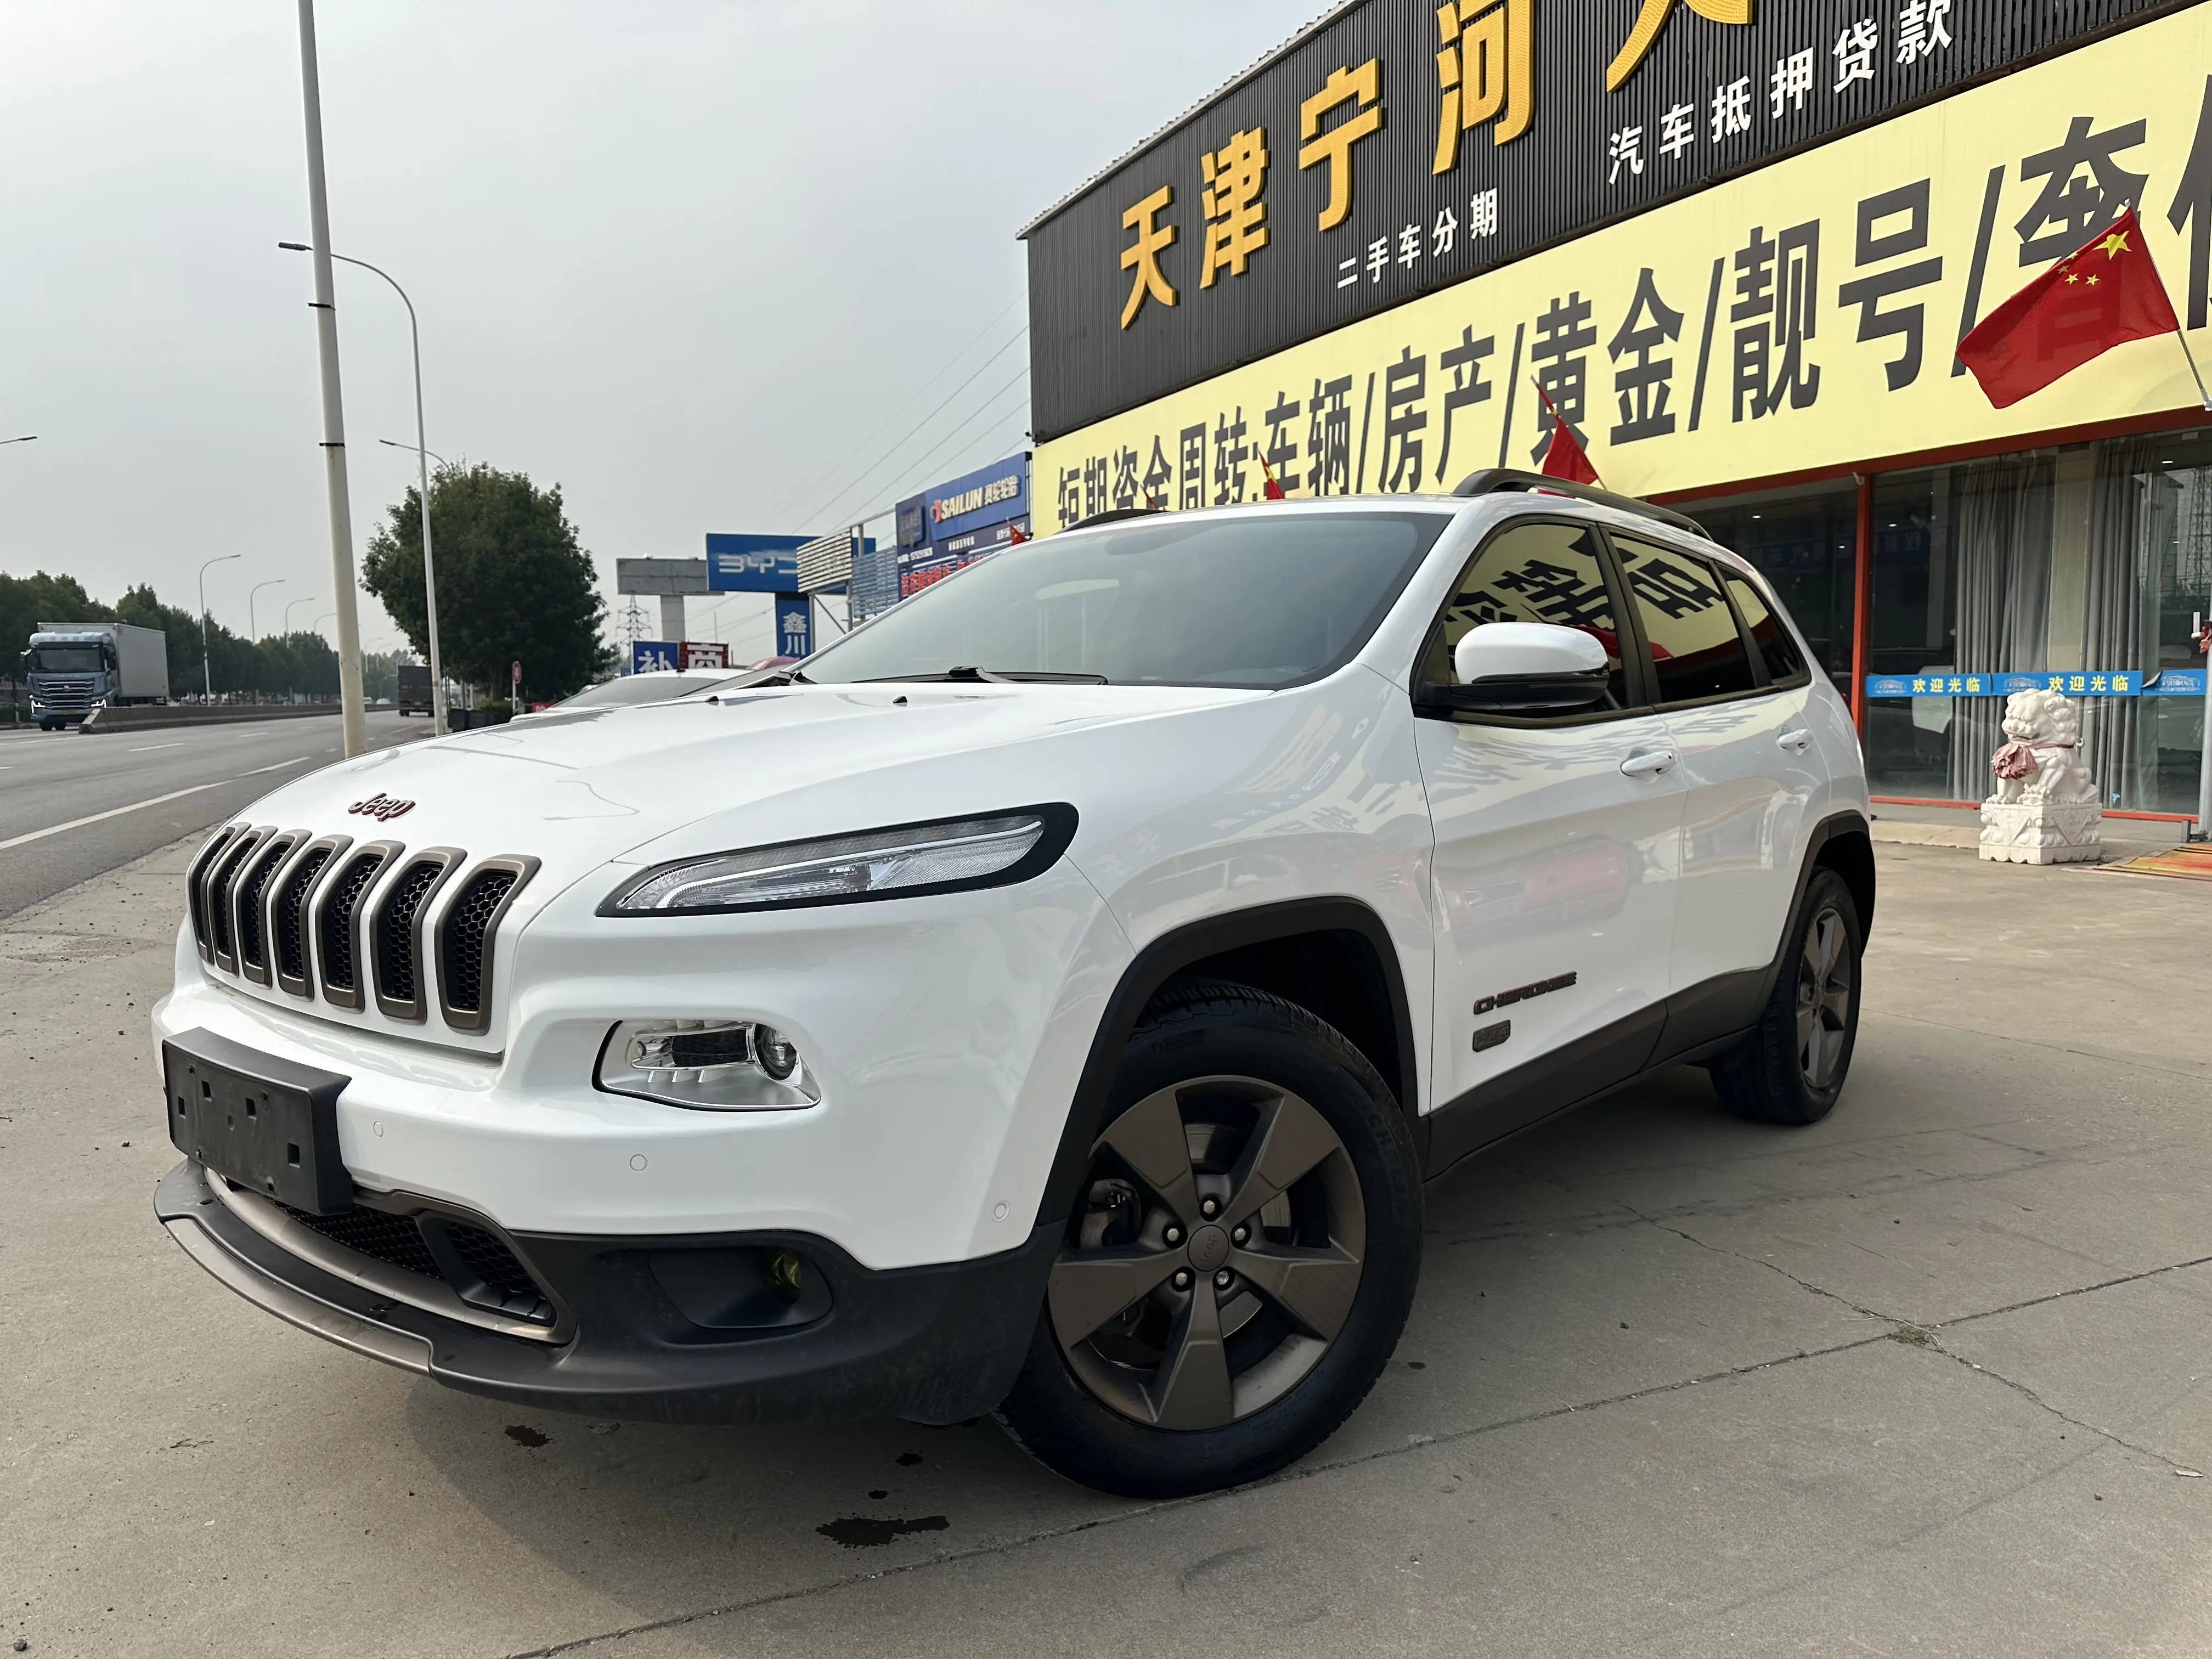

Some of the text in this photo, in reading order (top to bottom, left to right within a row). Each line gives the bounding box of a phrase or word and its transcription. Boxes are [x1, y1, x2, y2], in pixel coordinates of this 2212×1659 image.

[1337, 0, 1953, 289] 二手车分期 汽车抵押贷款
[941, 487, 982, 520] SAILUN
[783, 611, 806, 656] 鑫川
[1912, 676, 1980, 693] 欢迎光临
[2048, 674, 2129, 692] 欢迎光临
[348, 793, 416, 822] Jeep
[1474, 970, 1577, 1015] CHEROKEE
